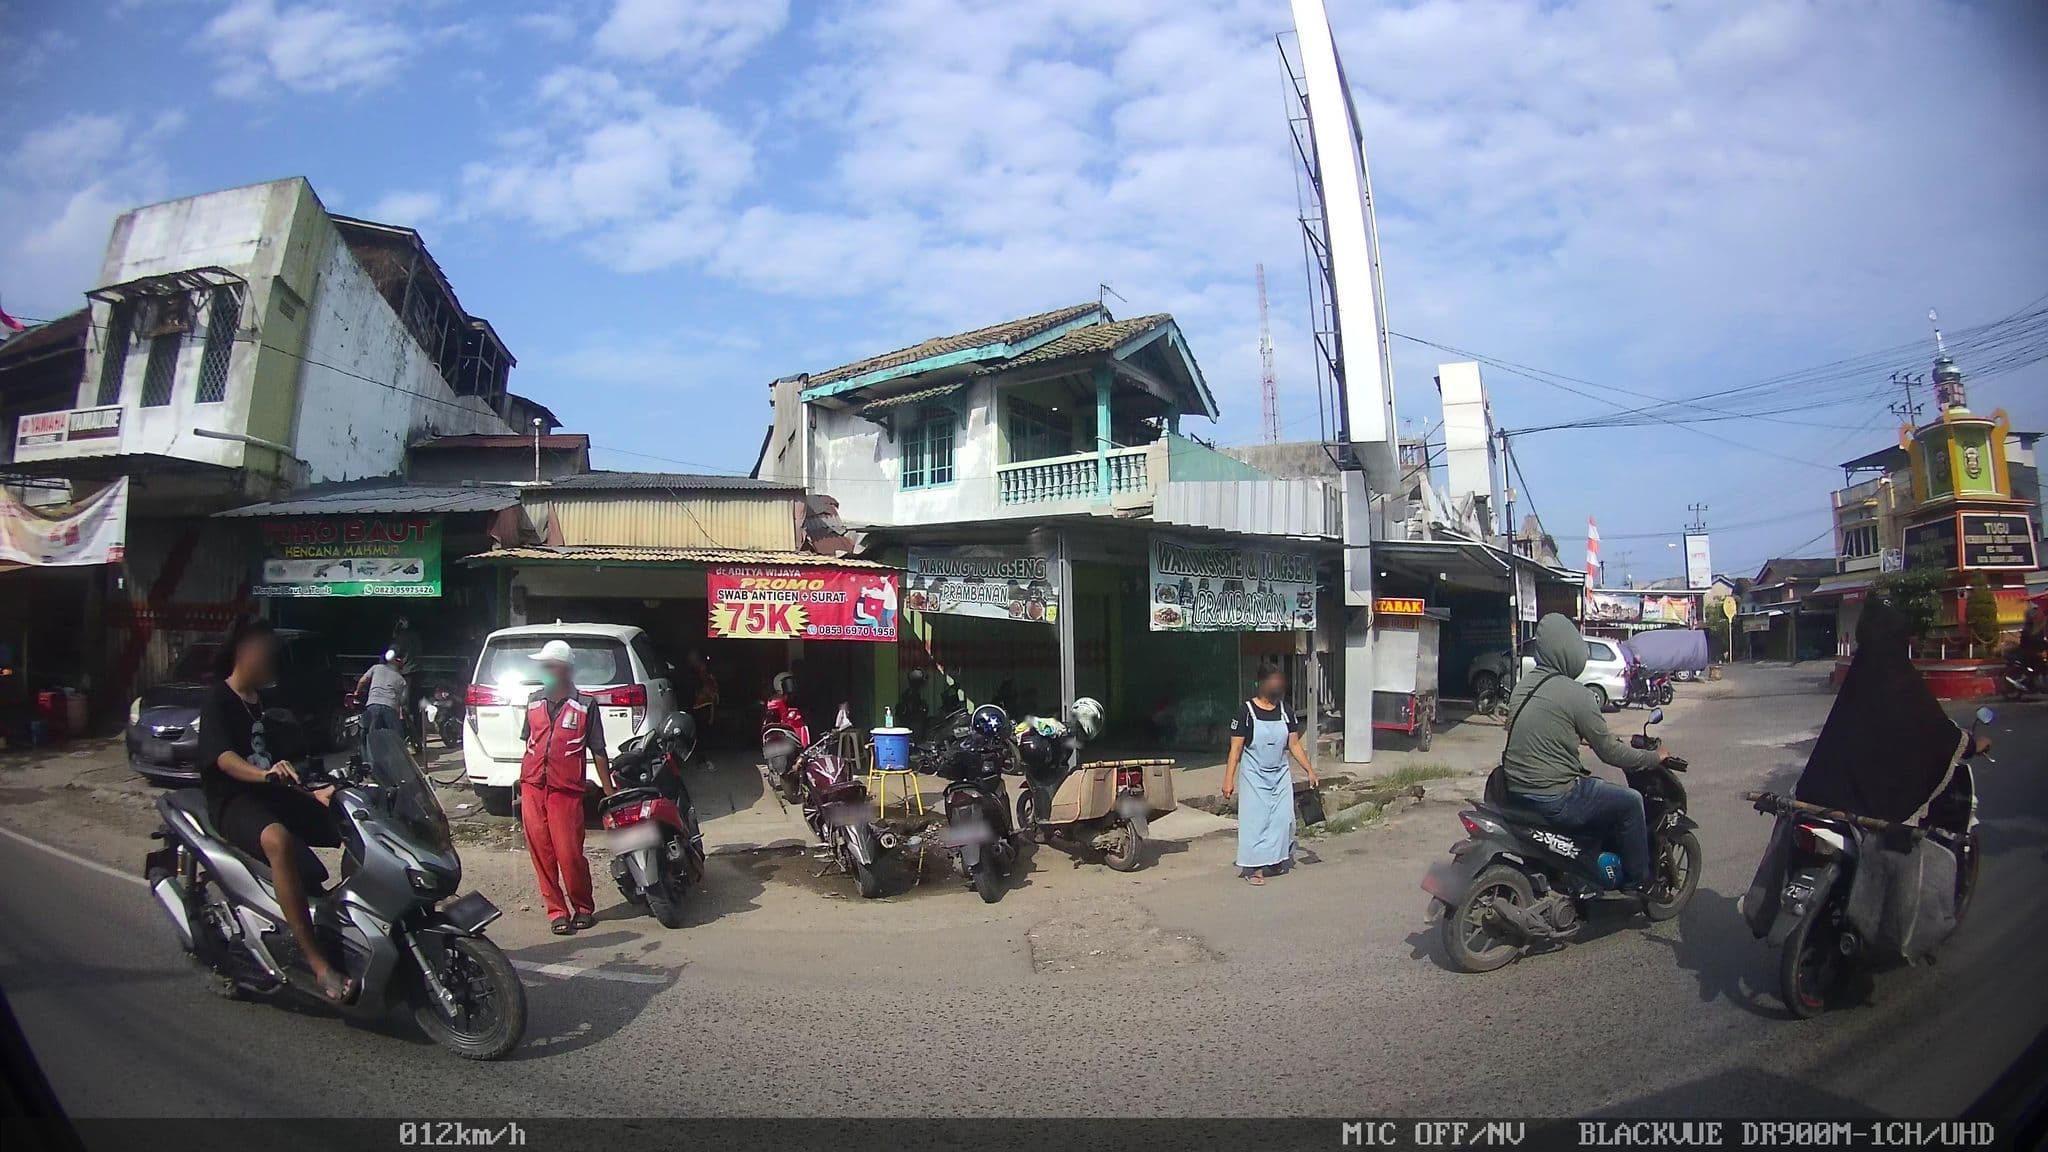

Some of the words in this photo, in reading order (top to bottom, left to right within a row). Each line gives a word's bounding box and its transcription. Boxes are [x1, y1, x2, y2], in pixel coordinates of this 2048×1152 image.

[343, 519, 432, 543] BAUT
[1984, 522, 2009, 534] TUGU
[728, 568, 763, 576] ADITYA
[765, 569, 801, 577] WIJAYA
[919, 559, 969, 578] WARUNG
[1247, 554, 1257, 579] &
[740, 578, 824, 590] PROMO
[718, 590, 748, 601] SWAB
[752, 591, 799, 602] ANTIGEN
[942, 584, 1009, 605] PRAMBANAN
[1194, 591, 1286, 626] PRAMBANAN
[724, 603, 793, 635] 75K
[819, 626, 841, 634] 0853
[845, 627, 868, 635] 6970
[872, 627, 895, 636] 1958
